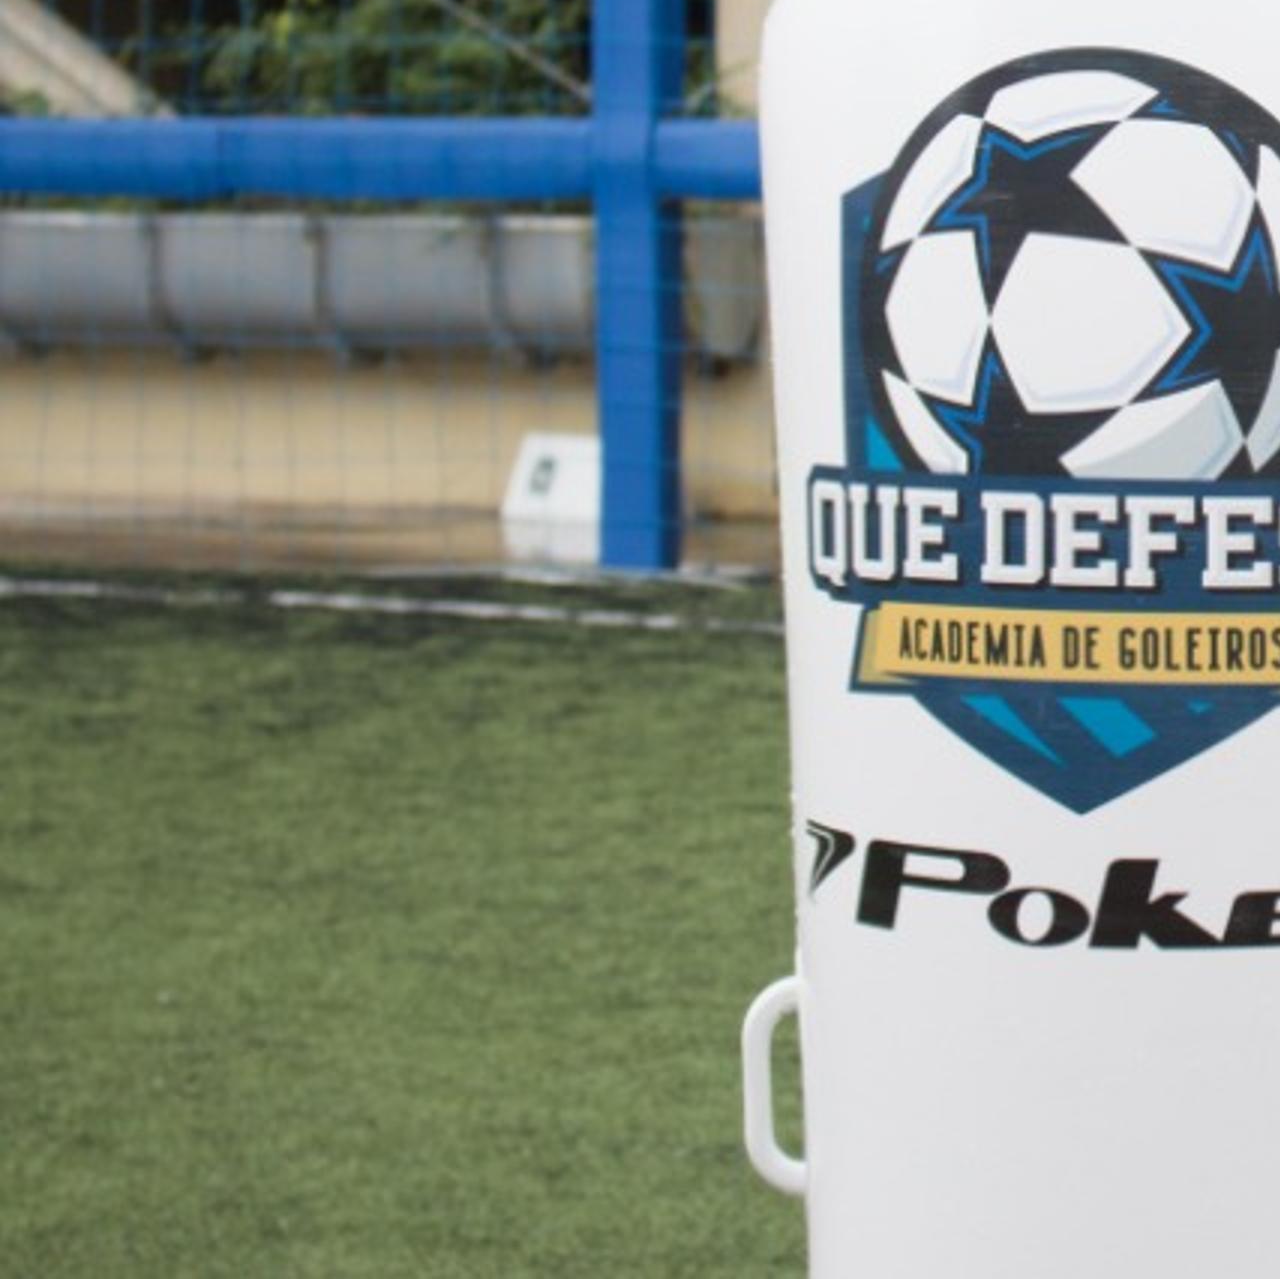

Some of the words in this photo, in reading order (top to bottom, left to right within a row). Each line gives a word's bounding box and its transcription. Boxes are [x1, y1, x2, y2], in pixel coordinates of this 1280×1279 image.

[808, 477, 960, 589] QUE
[898, 615, 1048, 671] ACADEMIA
[1061, 622, 1101, 671] DE
